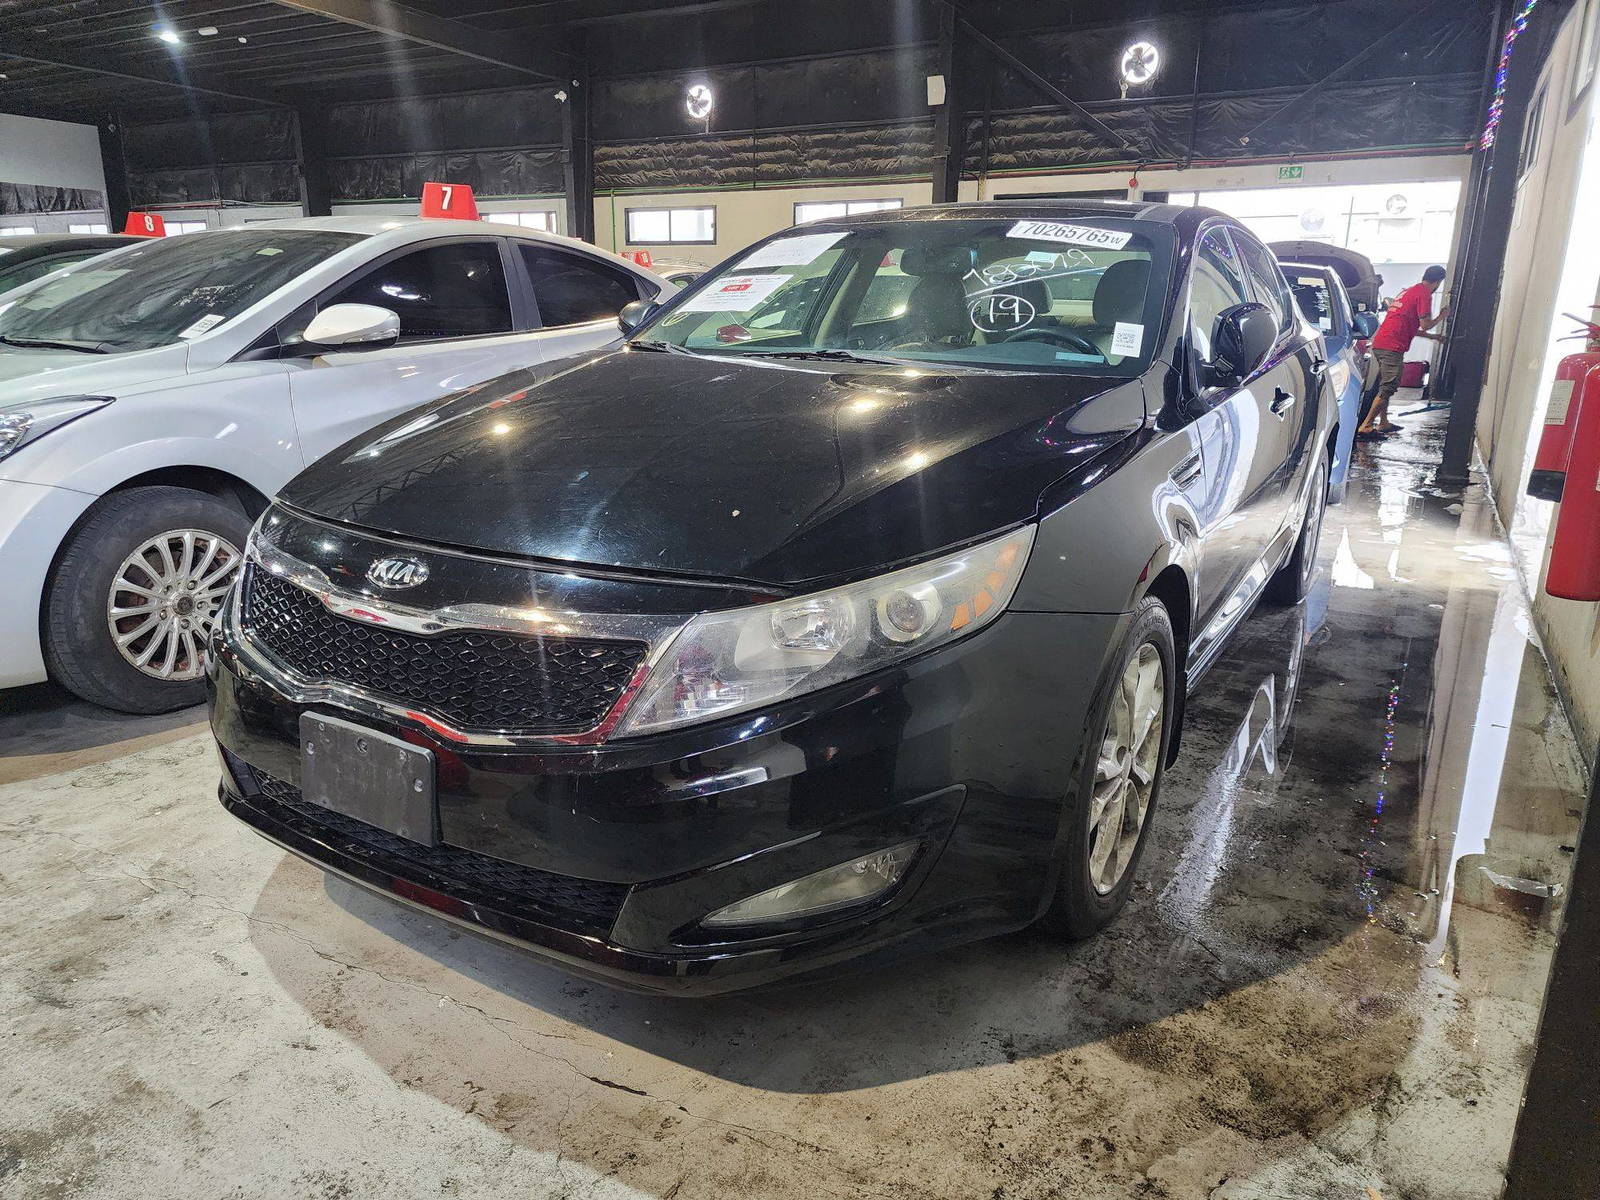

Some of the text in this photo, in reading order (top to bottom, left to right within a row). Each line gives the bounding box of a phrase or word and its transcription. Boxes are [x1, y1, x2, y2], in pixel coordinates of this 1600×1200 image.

[442, 186, 453, 210] 7
[144, 215, 155, 232] 8
[989, 296, 1021, 324] 19
[372, 559, 416, 583] KIA
